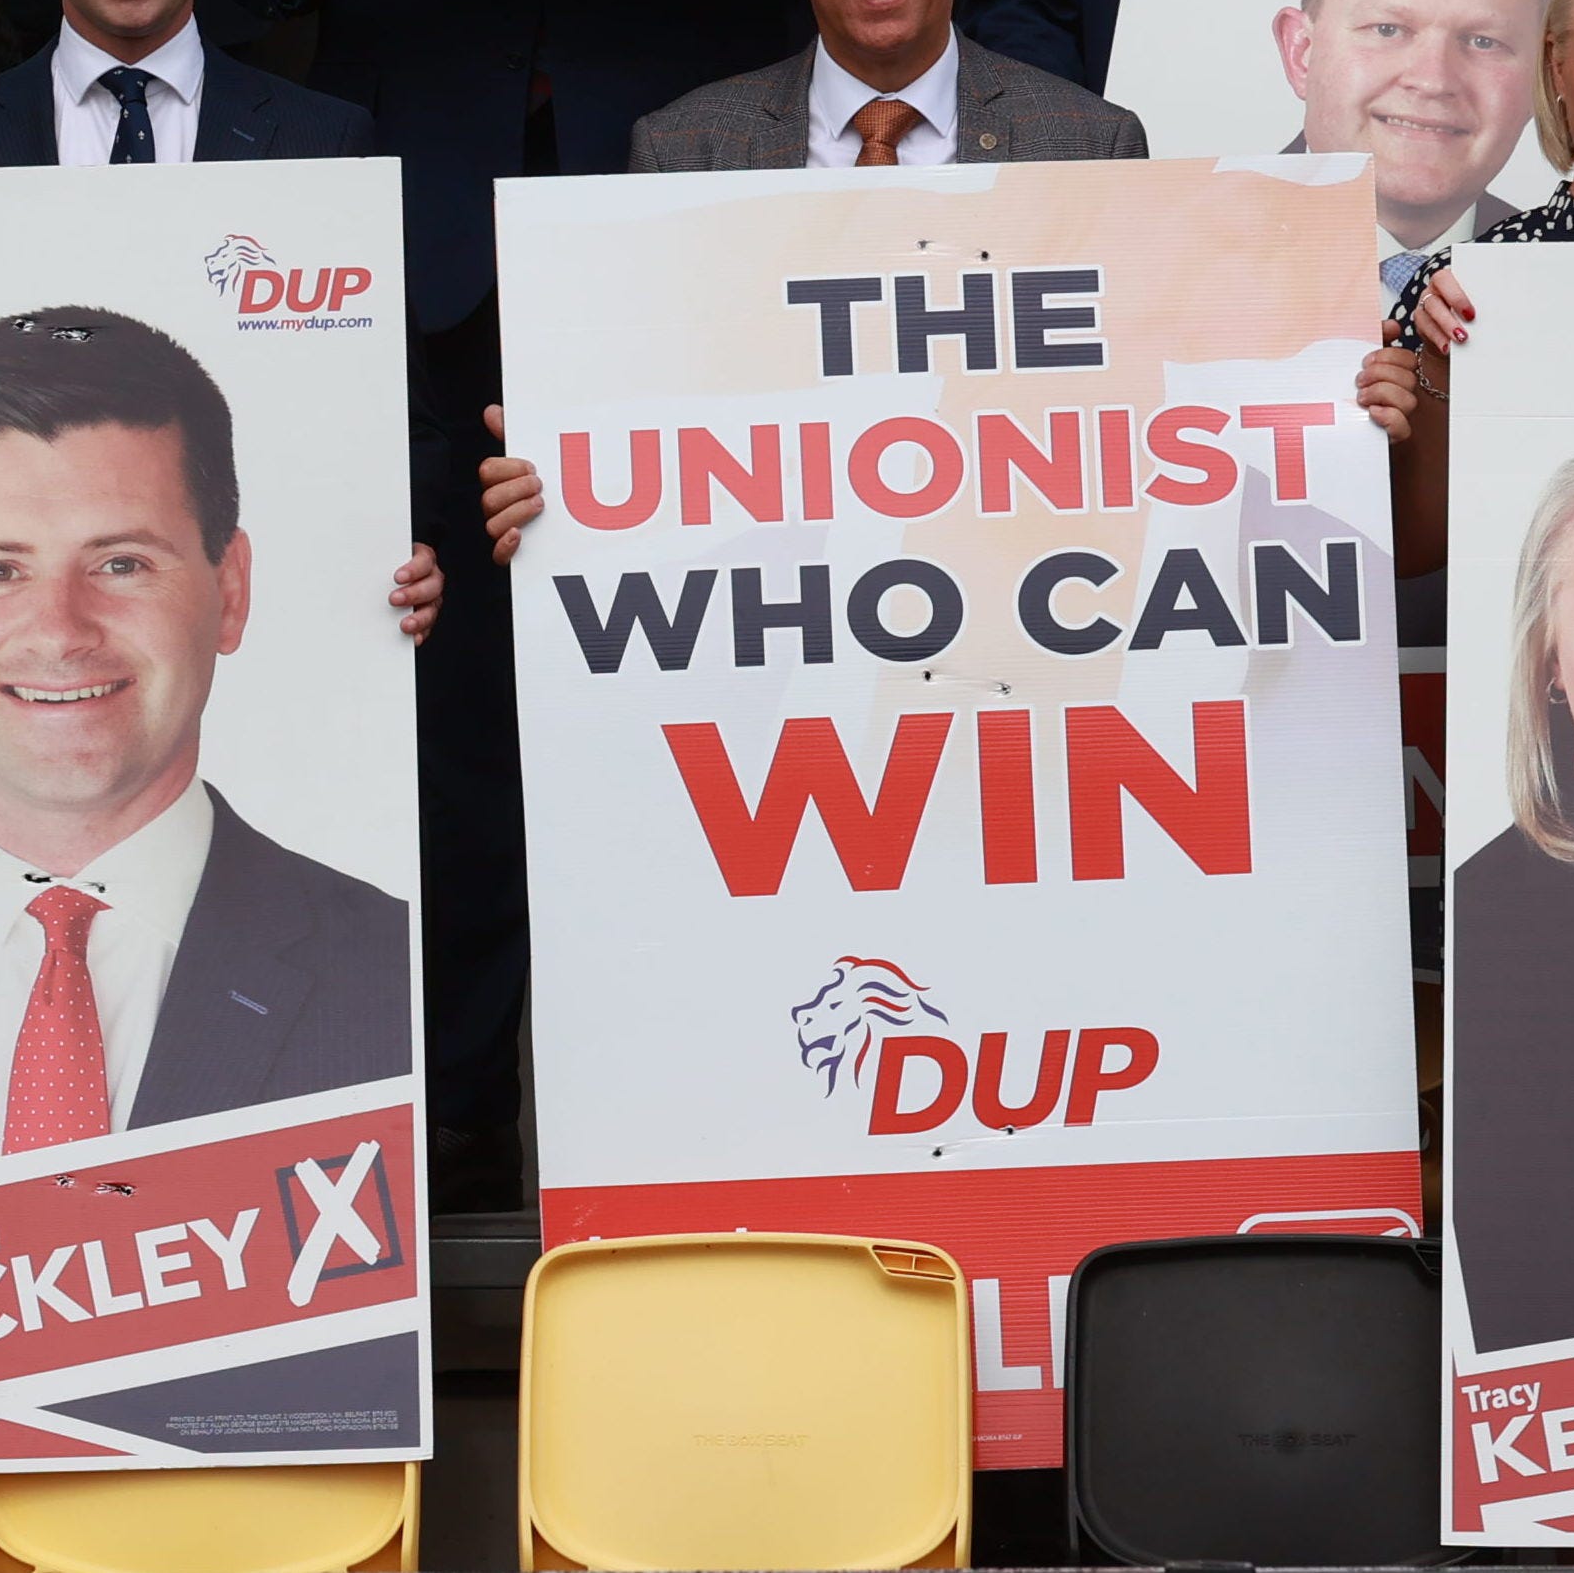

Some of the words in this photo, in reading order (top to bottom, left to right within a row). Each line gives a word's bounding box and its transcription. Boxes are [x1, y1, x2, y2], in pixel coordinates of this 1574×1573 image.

[237, 316, 373, 332] www.mydup.com
[238, 267, 372, 314] DUP
[786, 267, 1106, 377] THE
[559, 401, 1336, 532] UNIONIST
[552, 557, 965, 675] WHO
[1017, 540, 1364, 656] CAN
[660, 699, 1253, 899] WIN
[867, 1027, 1159, 1136] DUP
[1461, 1381, 1541, 1414] Tracy
